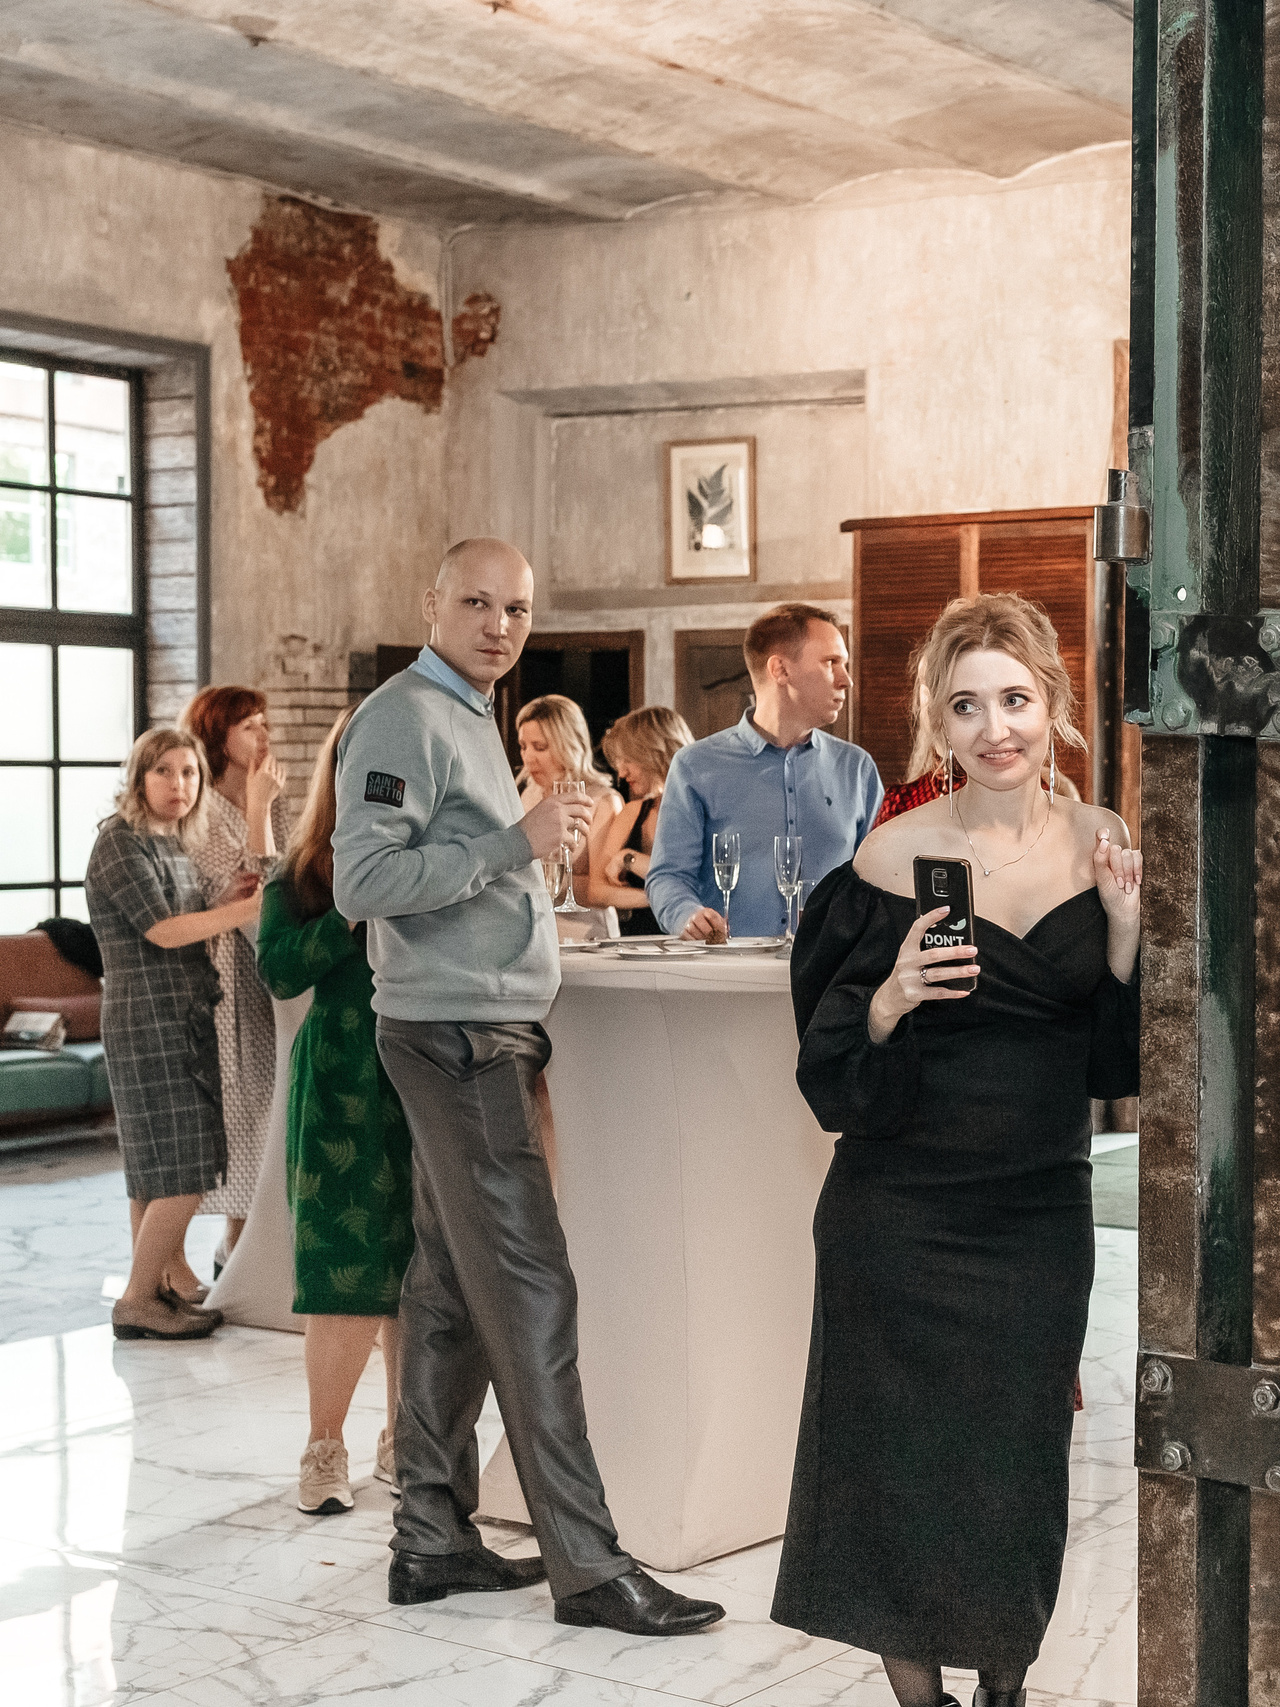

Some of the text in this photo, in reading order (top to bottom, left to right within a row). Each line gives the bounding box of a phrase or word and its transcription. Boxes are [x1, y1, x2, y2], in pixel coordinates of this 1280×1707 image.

[369, 774, 397, 788] SAINT
[367, 784, 402, 802] GHETTO
[925, 933, 964, 946] DON'T
